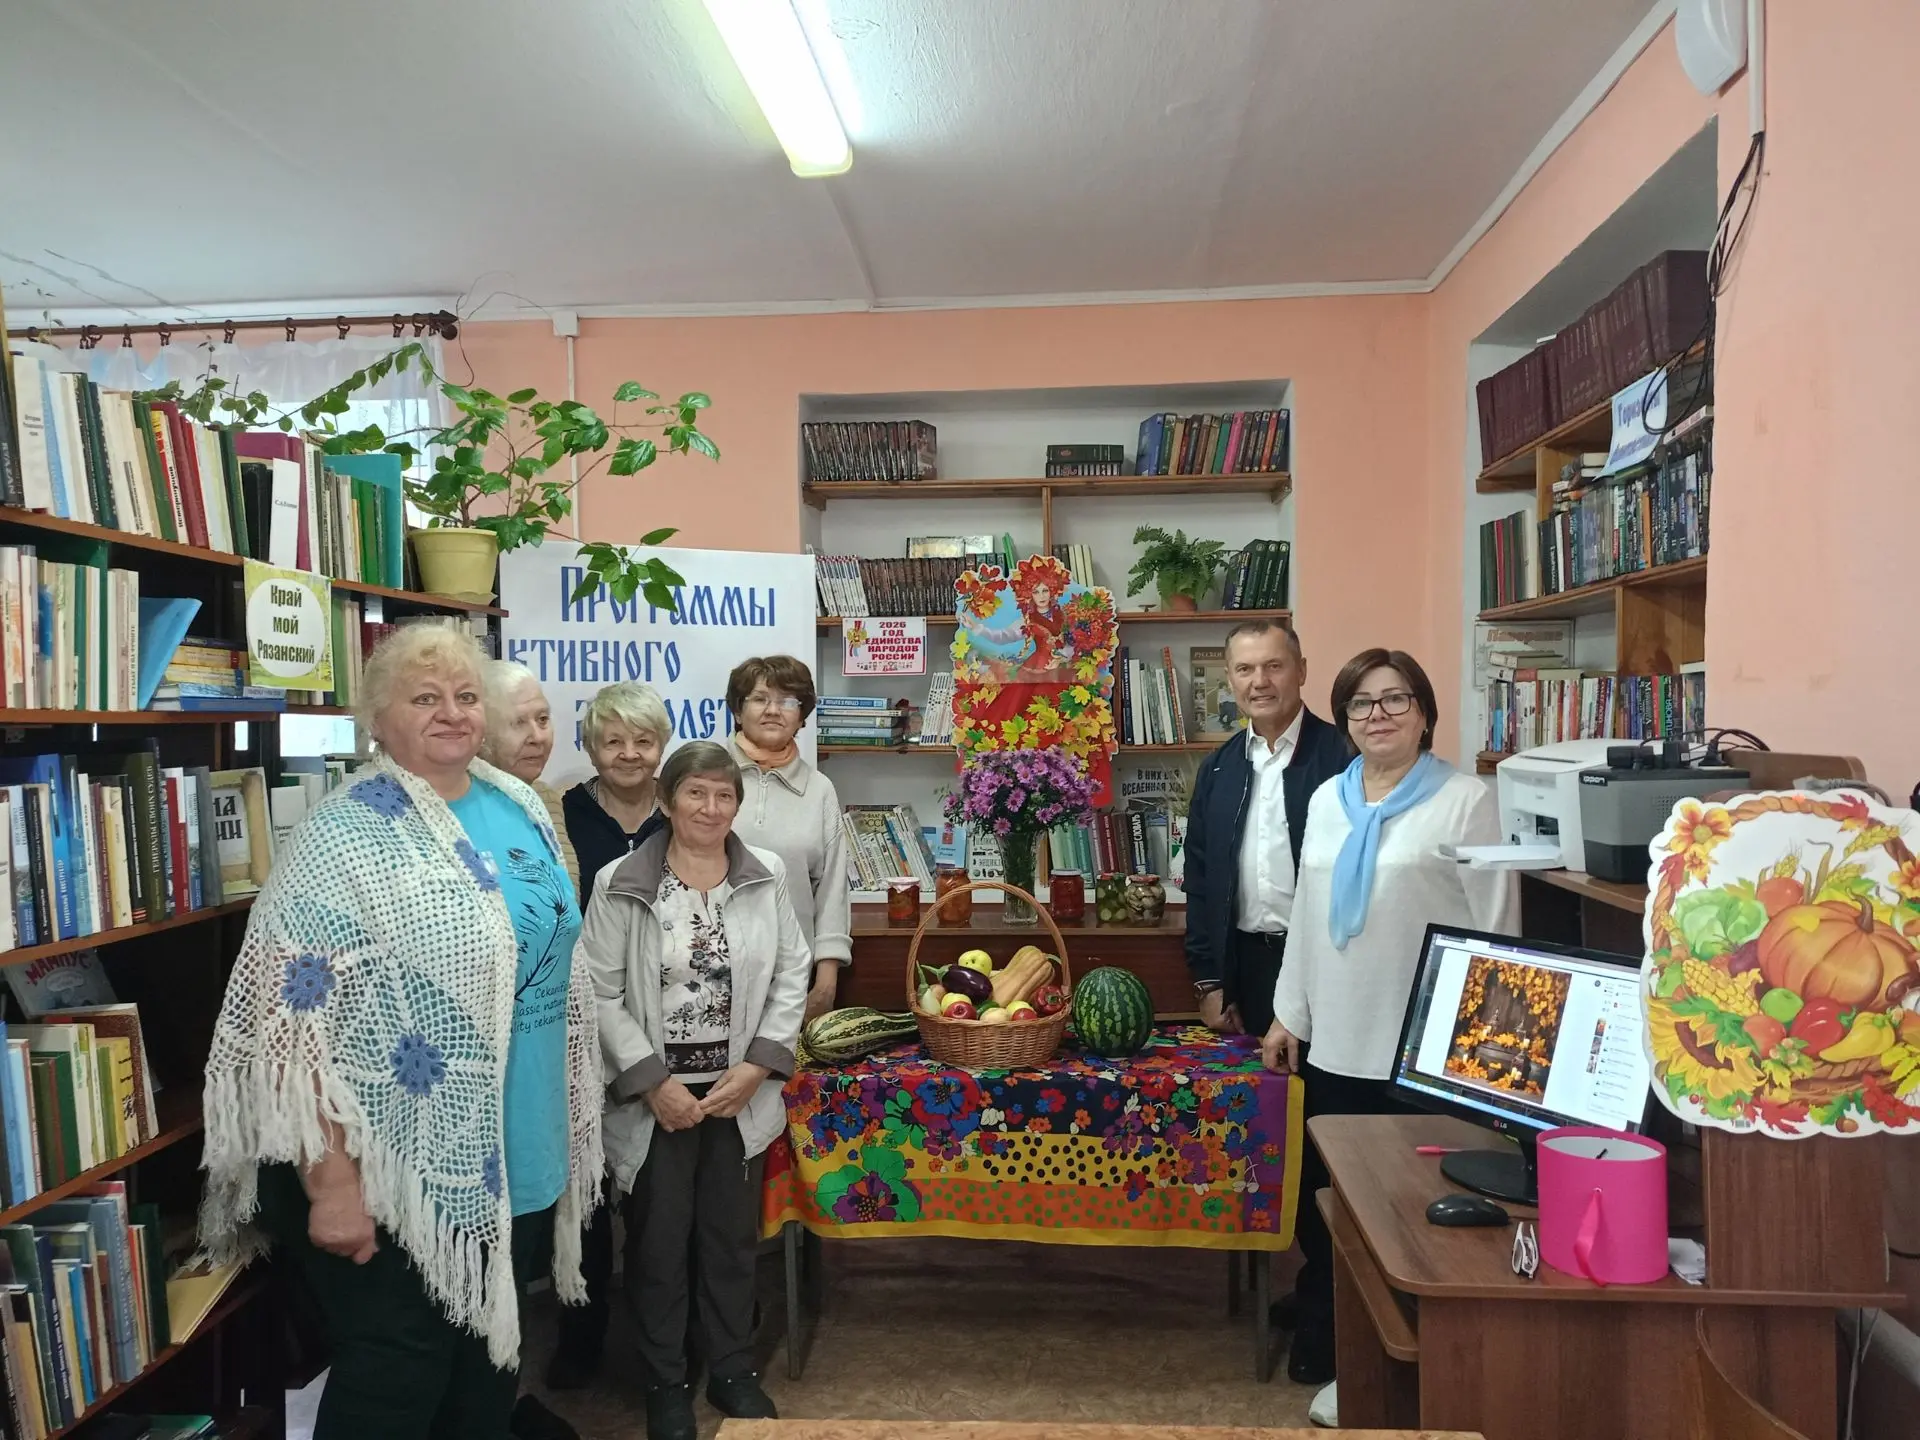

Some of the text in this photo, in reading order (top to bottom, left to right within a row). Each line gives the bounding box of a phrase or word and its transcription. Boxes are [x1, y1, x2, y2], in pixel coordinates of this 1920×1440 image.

[270, 584, 302, 608] Край
[273, 614, 299, 635] мой
[879, 621, 907, 629] 2026
[882, 629, 904, 637] ГОД
[865, 637, 922, 645] ЕДИНСТВА
[257, 639, 315, 664] Рязанский
[868, 645, 919, 653] НАРОДОВ
[872, 653, 915, 661] РОССИИ
[1121, 782, 1167, 797] ВСЕЛЕННАЯ
